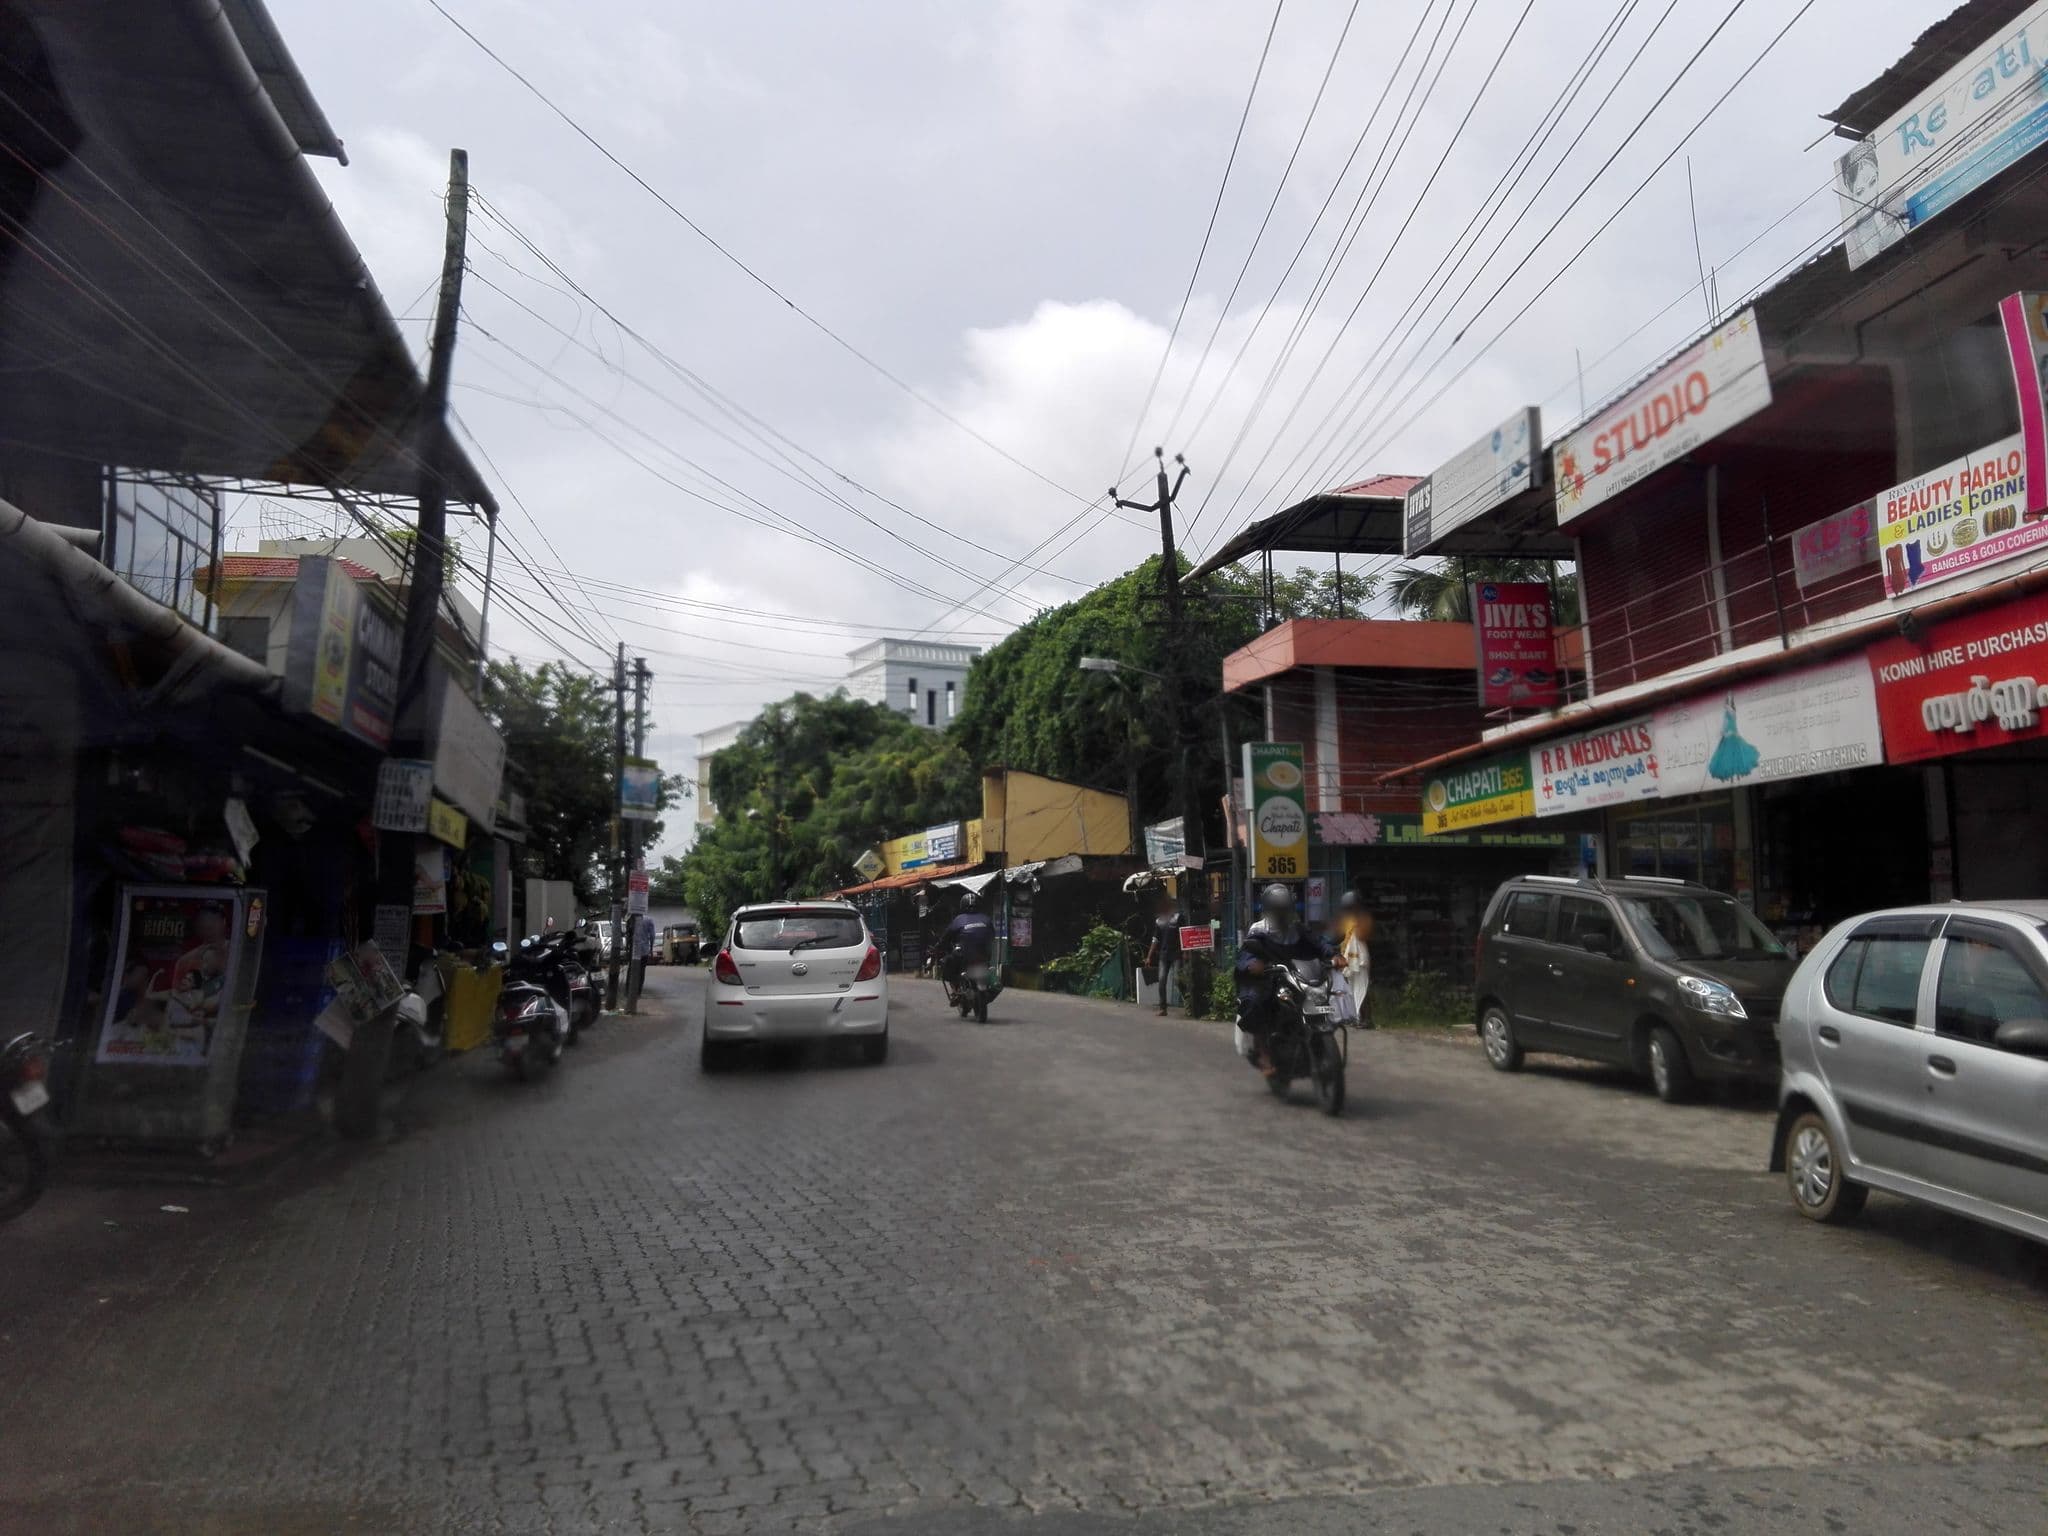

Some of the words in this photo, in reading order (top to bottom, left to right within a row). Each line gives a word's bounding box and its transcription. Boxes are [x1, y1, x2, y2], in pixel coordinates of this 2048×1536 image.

[1593, 371, 1709, 474] STUDIO
[1887, 475, 1953, 524] BEAUTY
[1888, 478, 1926, 500] REVATI
[1894, 526, 1904, 538] &
[1907, 500, 1962, 534] LADIES
[1932, 552, 1971, 573] BANGLES
[1972, 549, 1979, 559] &
[1980, 540, 2005, 558] GOLD
[2006, 526, 2048, 549] COVERIN
[1484, 603, 1547, 628] JIYA'S
[1487, 630, 1514, 639] FOOT
[1517, 630, 1546, 639] WEAR
[1489, 651, 1516, 660] SHOE
[1880, 656, 1925, 683] KONNI
[1928, 646, 1964, 672] HIRE
[1541, 750, 1553, 775] R
[1555, 746, 1567, 772] R
[1569, 724, 1652, 767] MEDICALS
[1809, 742, 1868, 771] STITCHING
[1261, 817, 1303, 838] Chapati
[1268, 857, 1296, 874] 365
